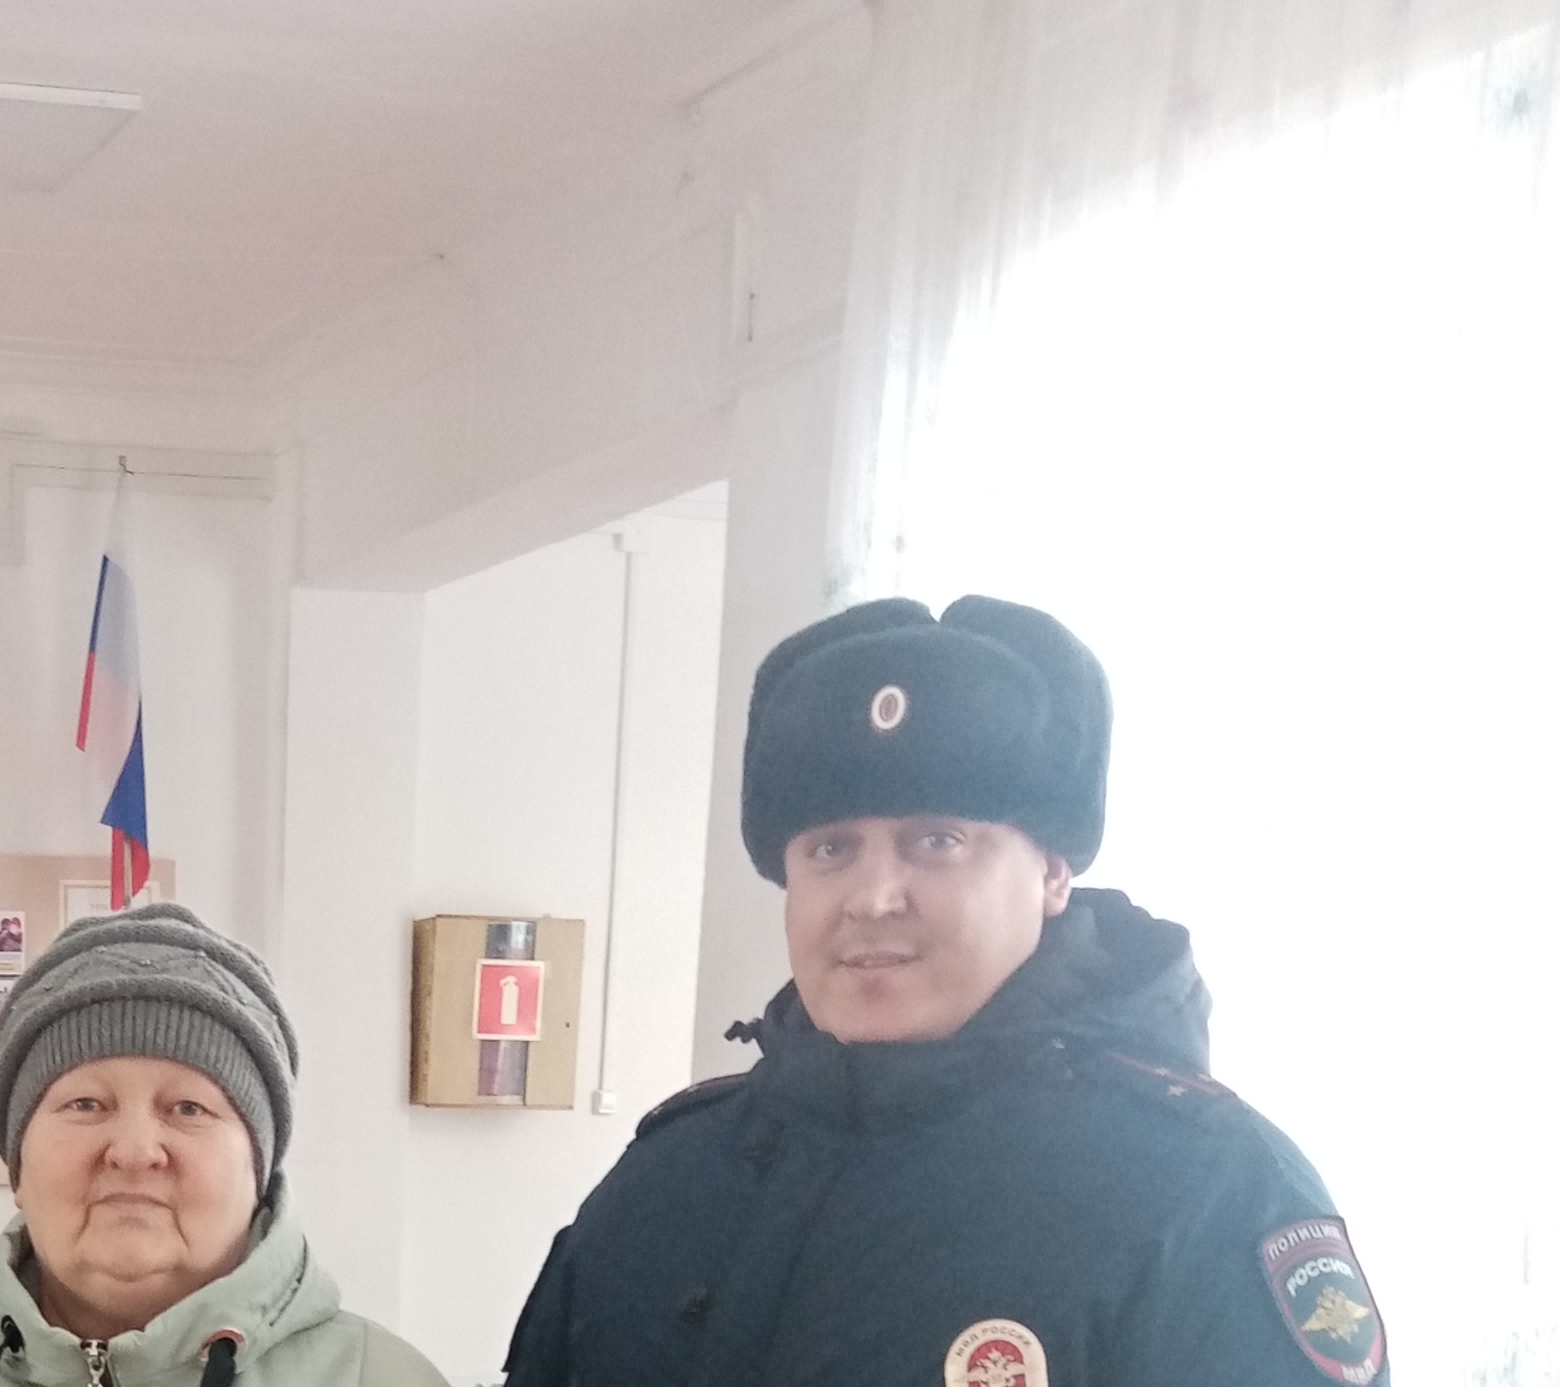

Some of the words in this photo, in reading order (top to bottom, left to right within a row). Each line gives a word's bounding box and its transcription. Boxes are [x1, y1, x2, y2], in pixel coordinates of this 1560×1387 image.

[1268, 1223, 1343, 1261] ПОЛИЦИЯ
[1285, 1256, 1355, 1298] РОССИЯ
[955, 1333, 979, 1358] МВД
[981, 1325, 1032, 1348] РОССИИ
